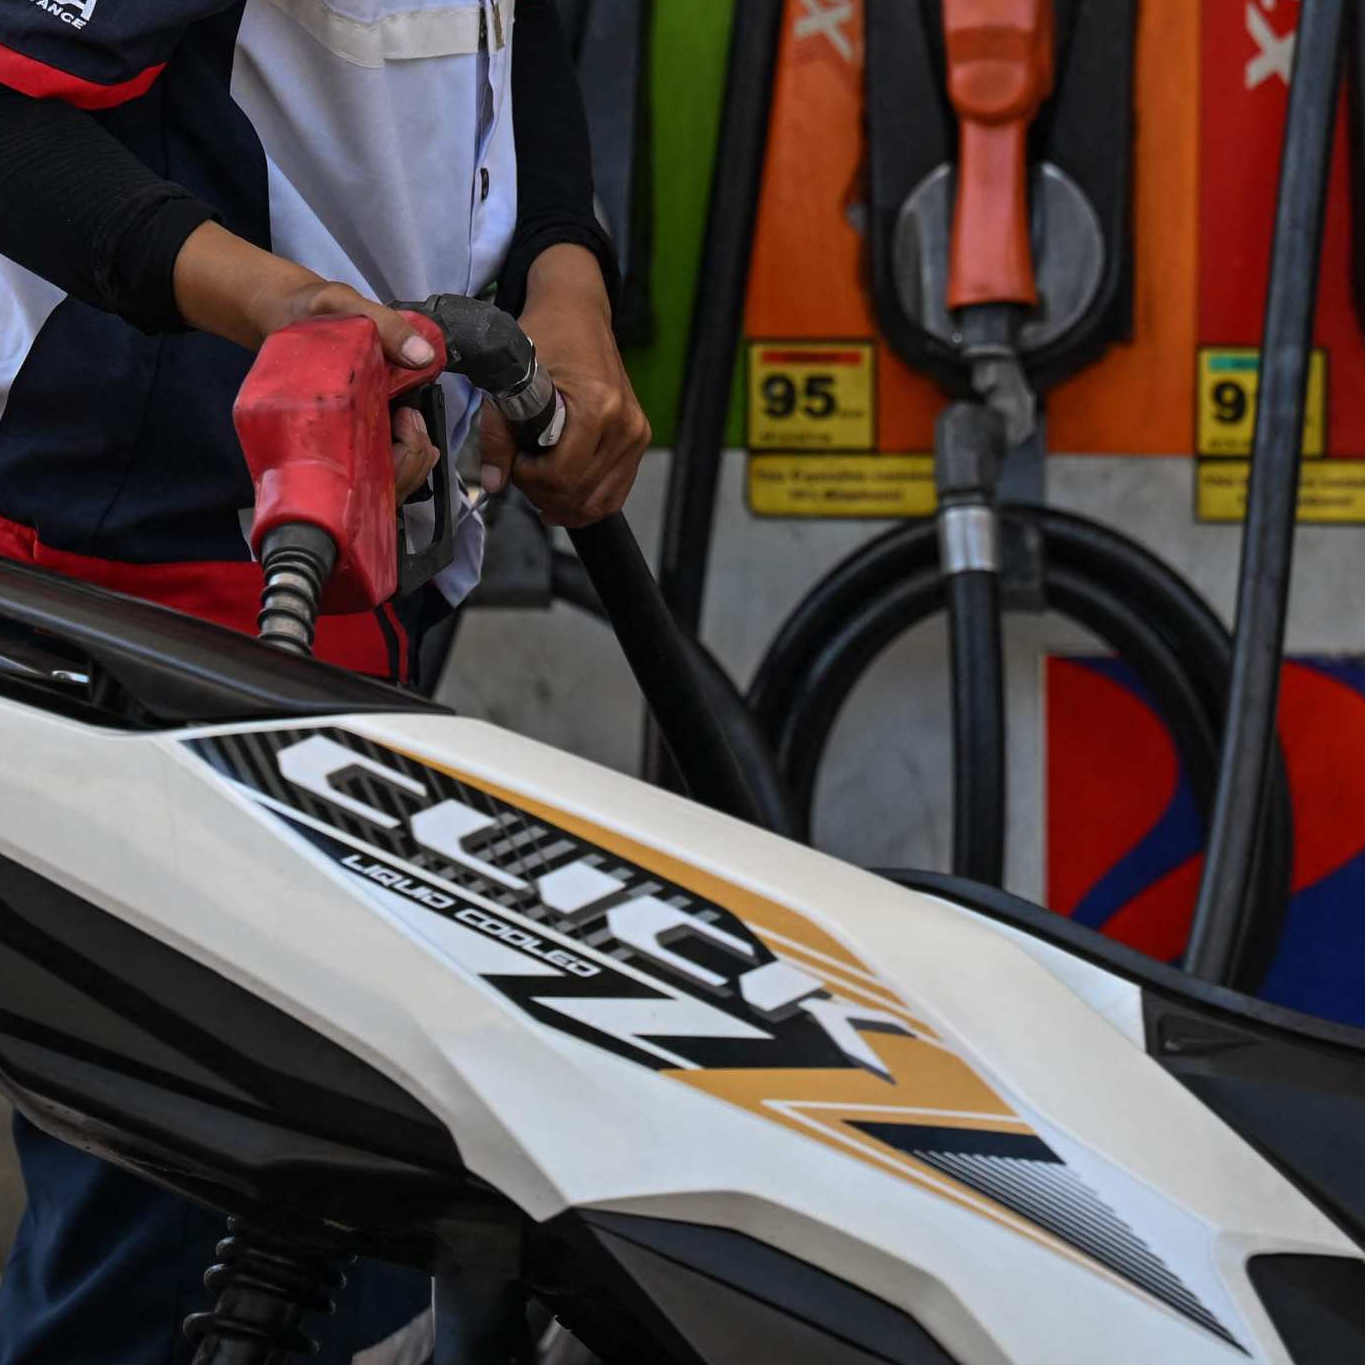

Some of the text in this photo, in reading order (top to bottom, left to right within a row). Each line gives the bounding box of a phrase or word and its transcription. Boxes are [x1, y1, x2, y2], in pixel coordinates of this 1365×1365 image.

[762, 373, 836, 420] 95
[1213, 382, 1248, 425] 9
[340, 855, 601, 978] LIQUID COOLED
